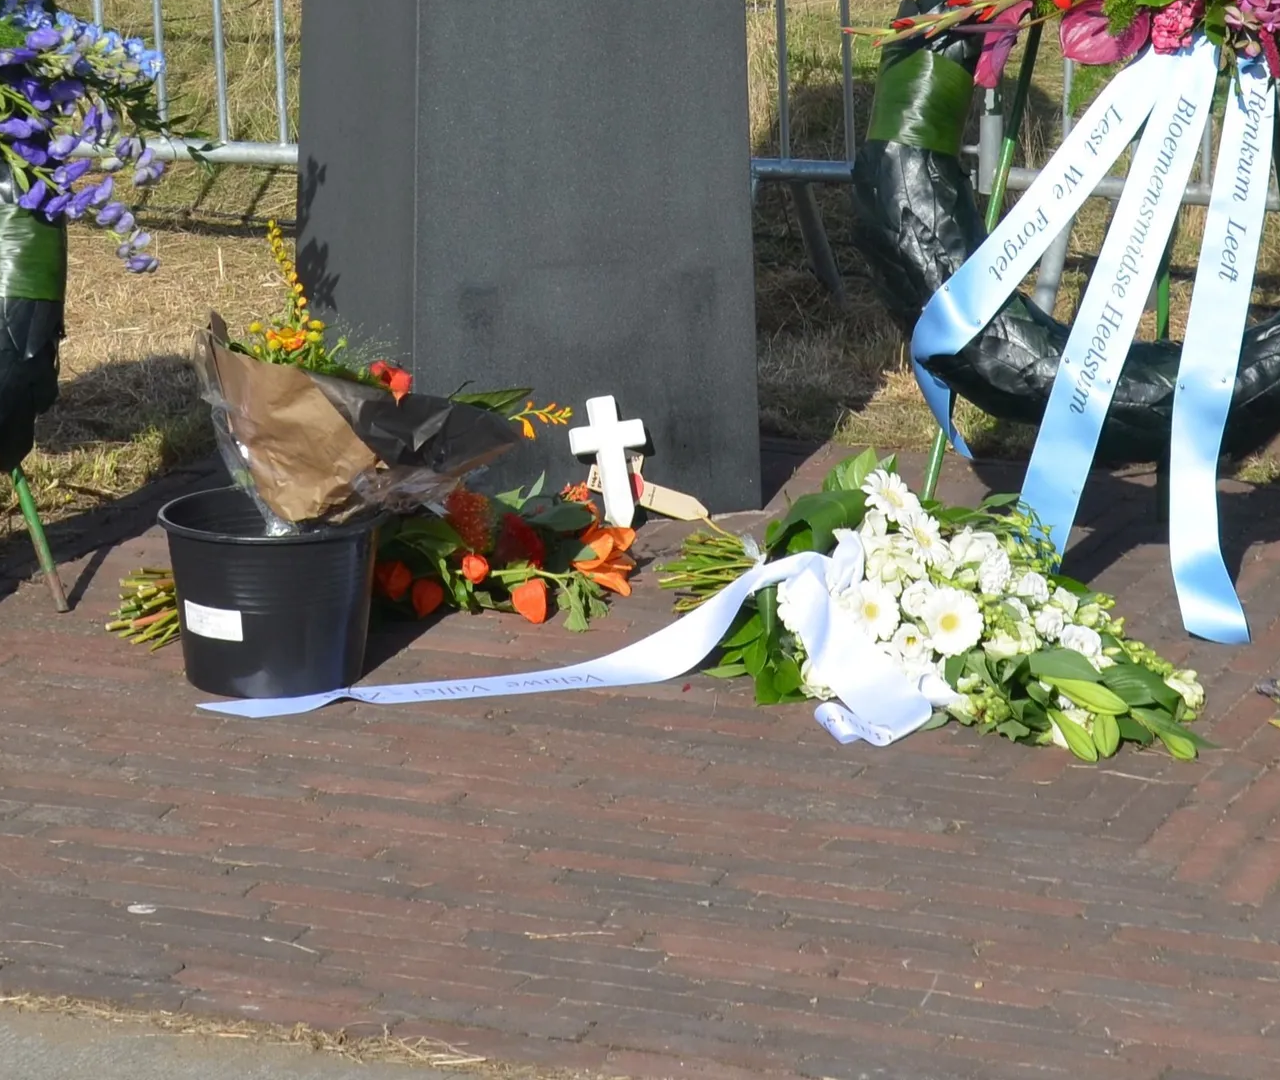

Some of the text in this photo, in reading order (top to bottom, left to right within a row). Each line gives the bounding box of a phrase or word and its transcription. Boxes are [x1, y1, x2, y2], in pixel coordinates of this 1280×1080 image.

[988, 104, 1124, 282] Lest We Forget
[1069, 93, 1198, 414] Bloemensmidse Heelsum
[1218, 88, 1267, 283] Renkum Leeft
